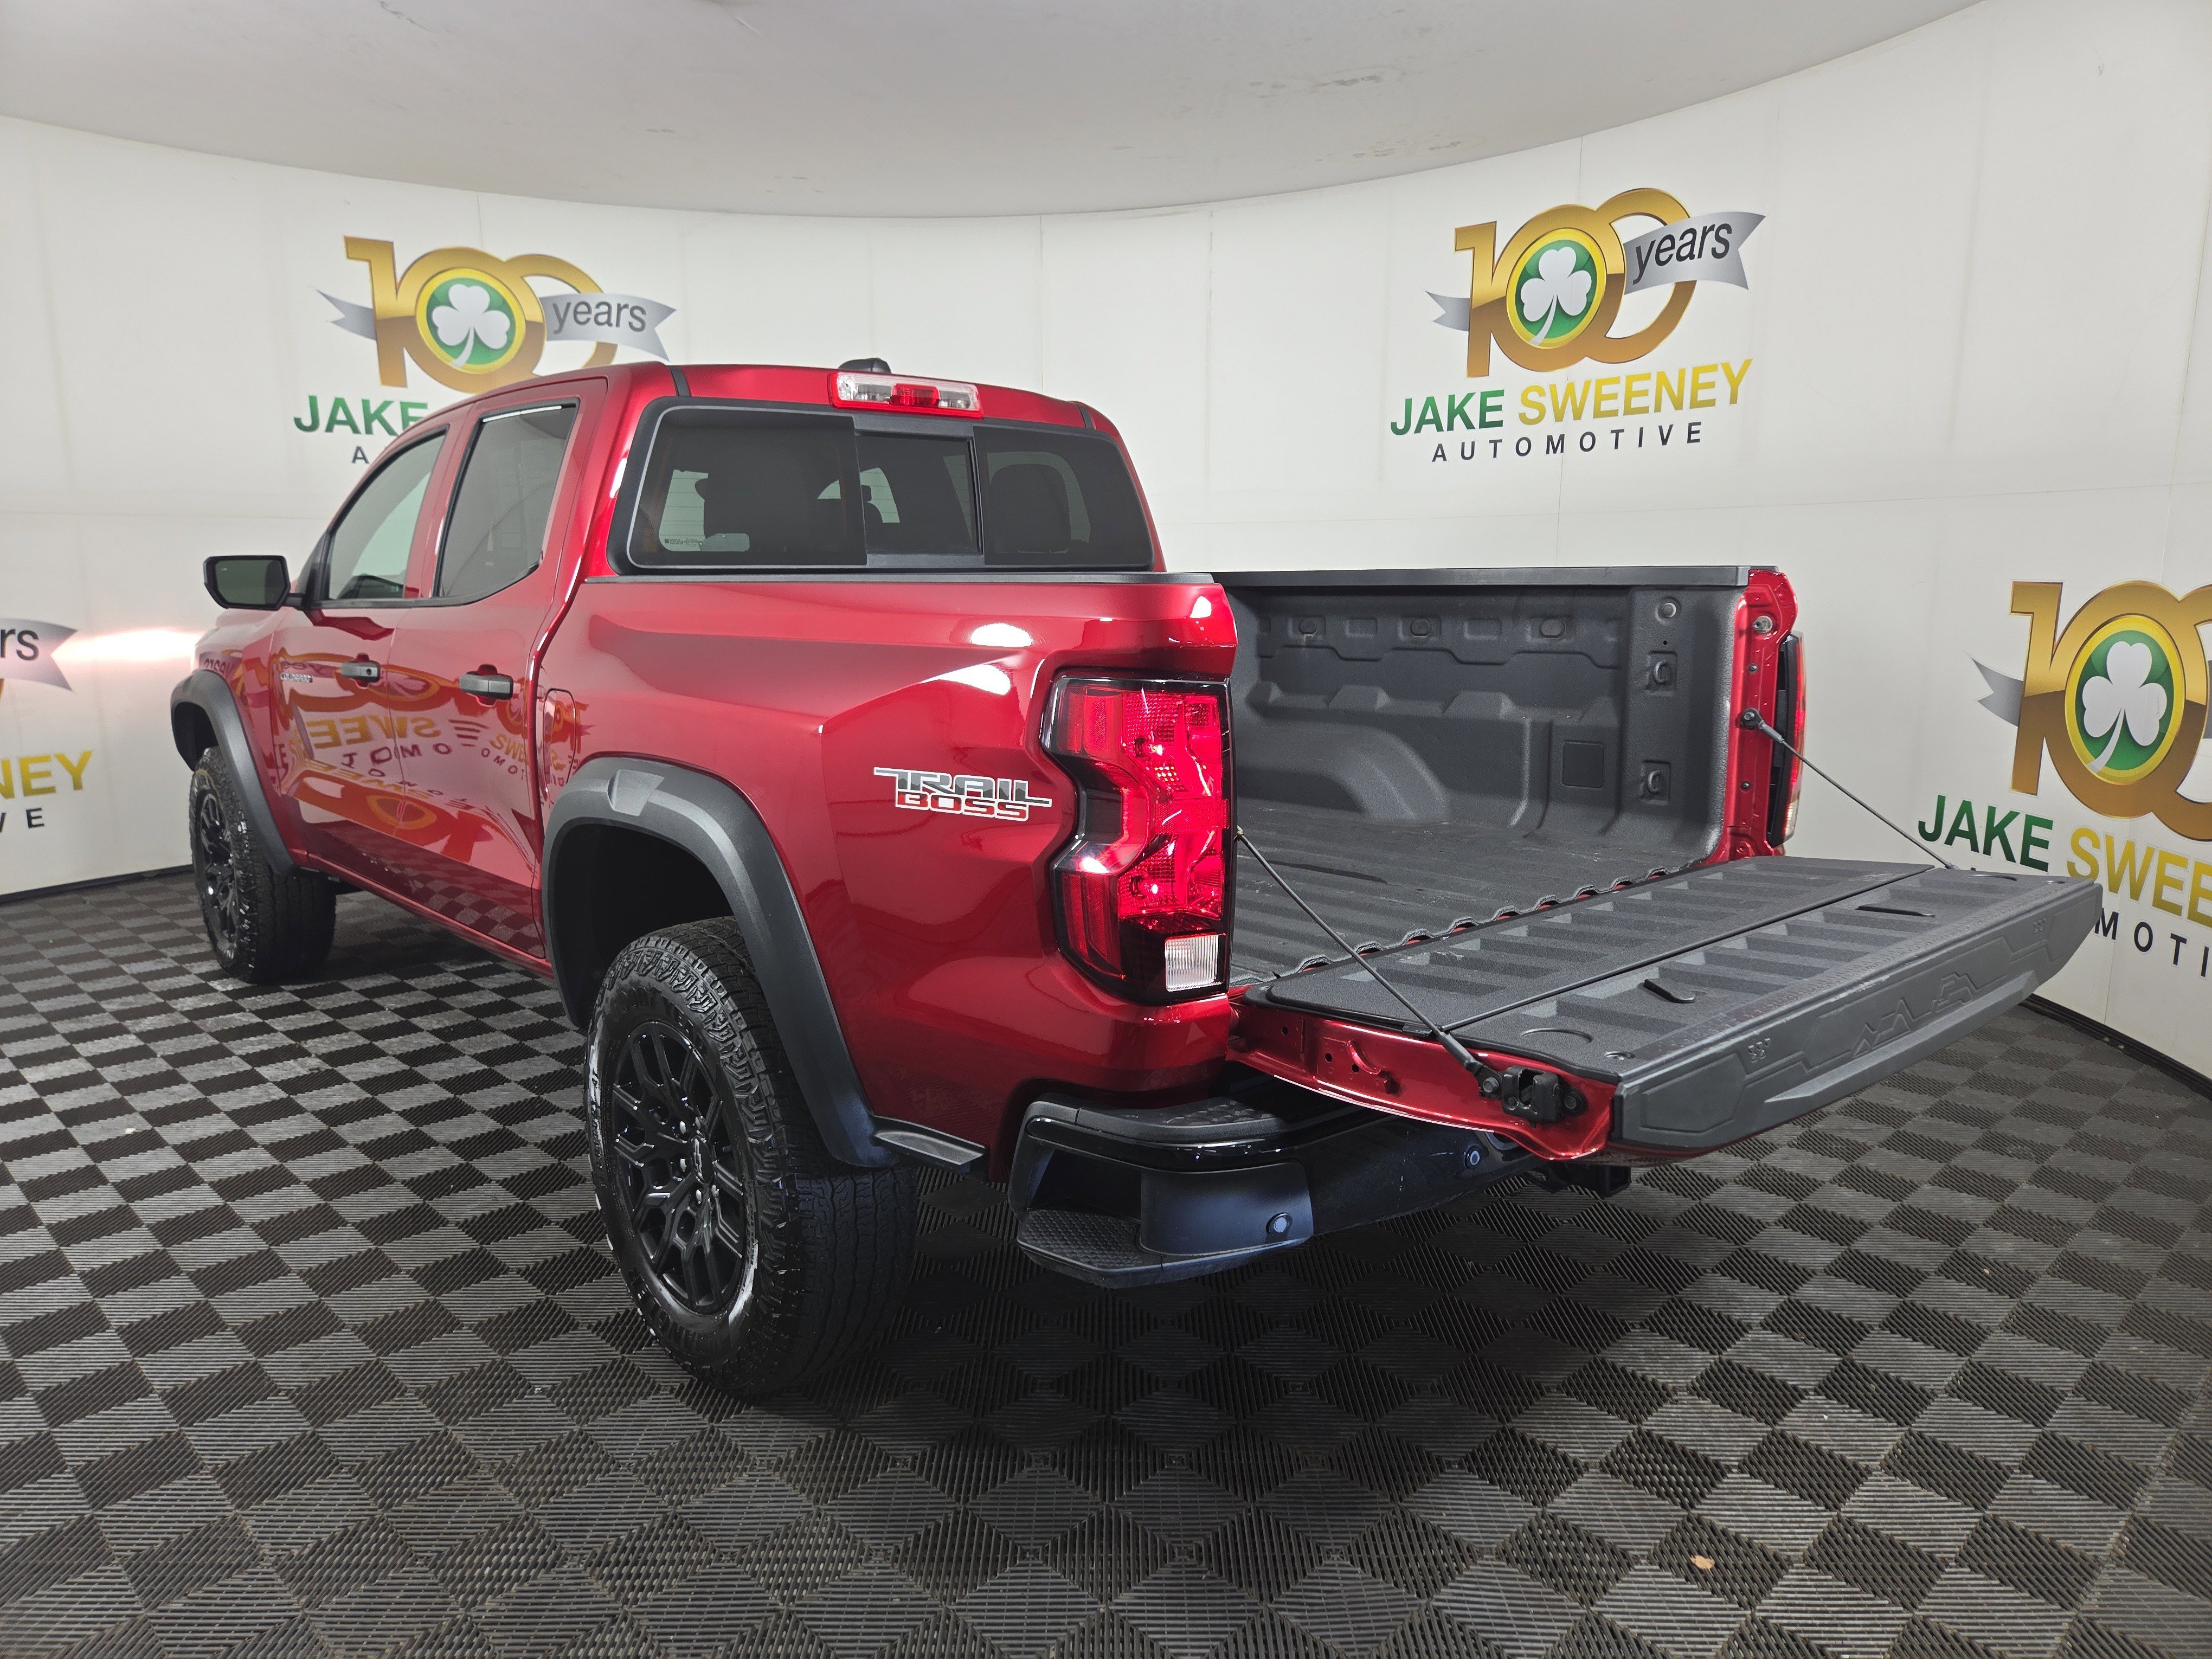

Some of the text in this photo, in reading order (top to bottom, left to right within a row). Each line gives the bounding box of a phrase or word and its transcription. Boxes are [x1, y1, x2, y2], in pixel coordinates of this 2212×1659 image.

[1632, 222, 1732, 285] years
[1455, 188, 1697, 378] 100
[552, 300, 647, 335] years
[1390, 358, 1753, 436] JAKE SWEENEY
[1431, 422, 1702, 462] AUTOMOTIVE
[873, 767, 1052, 808] TRAIL
[895, 790, 1029, 822] BOSS
[1918, 795, 2054, 872] JAKE
